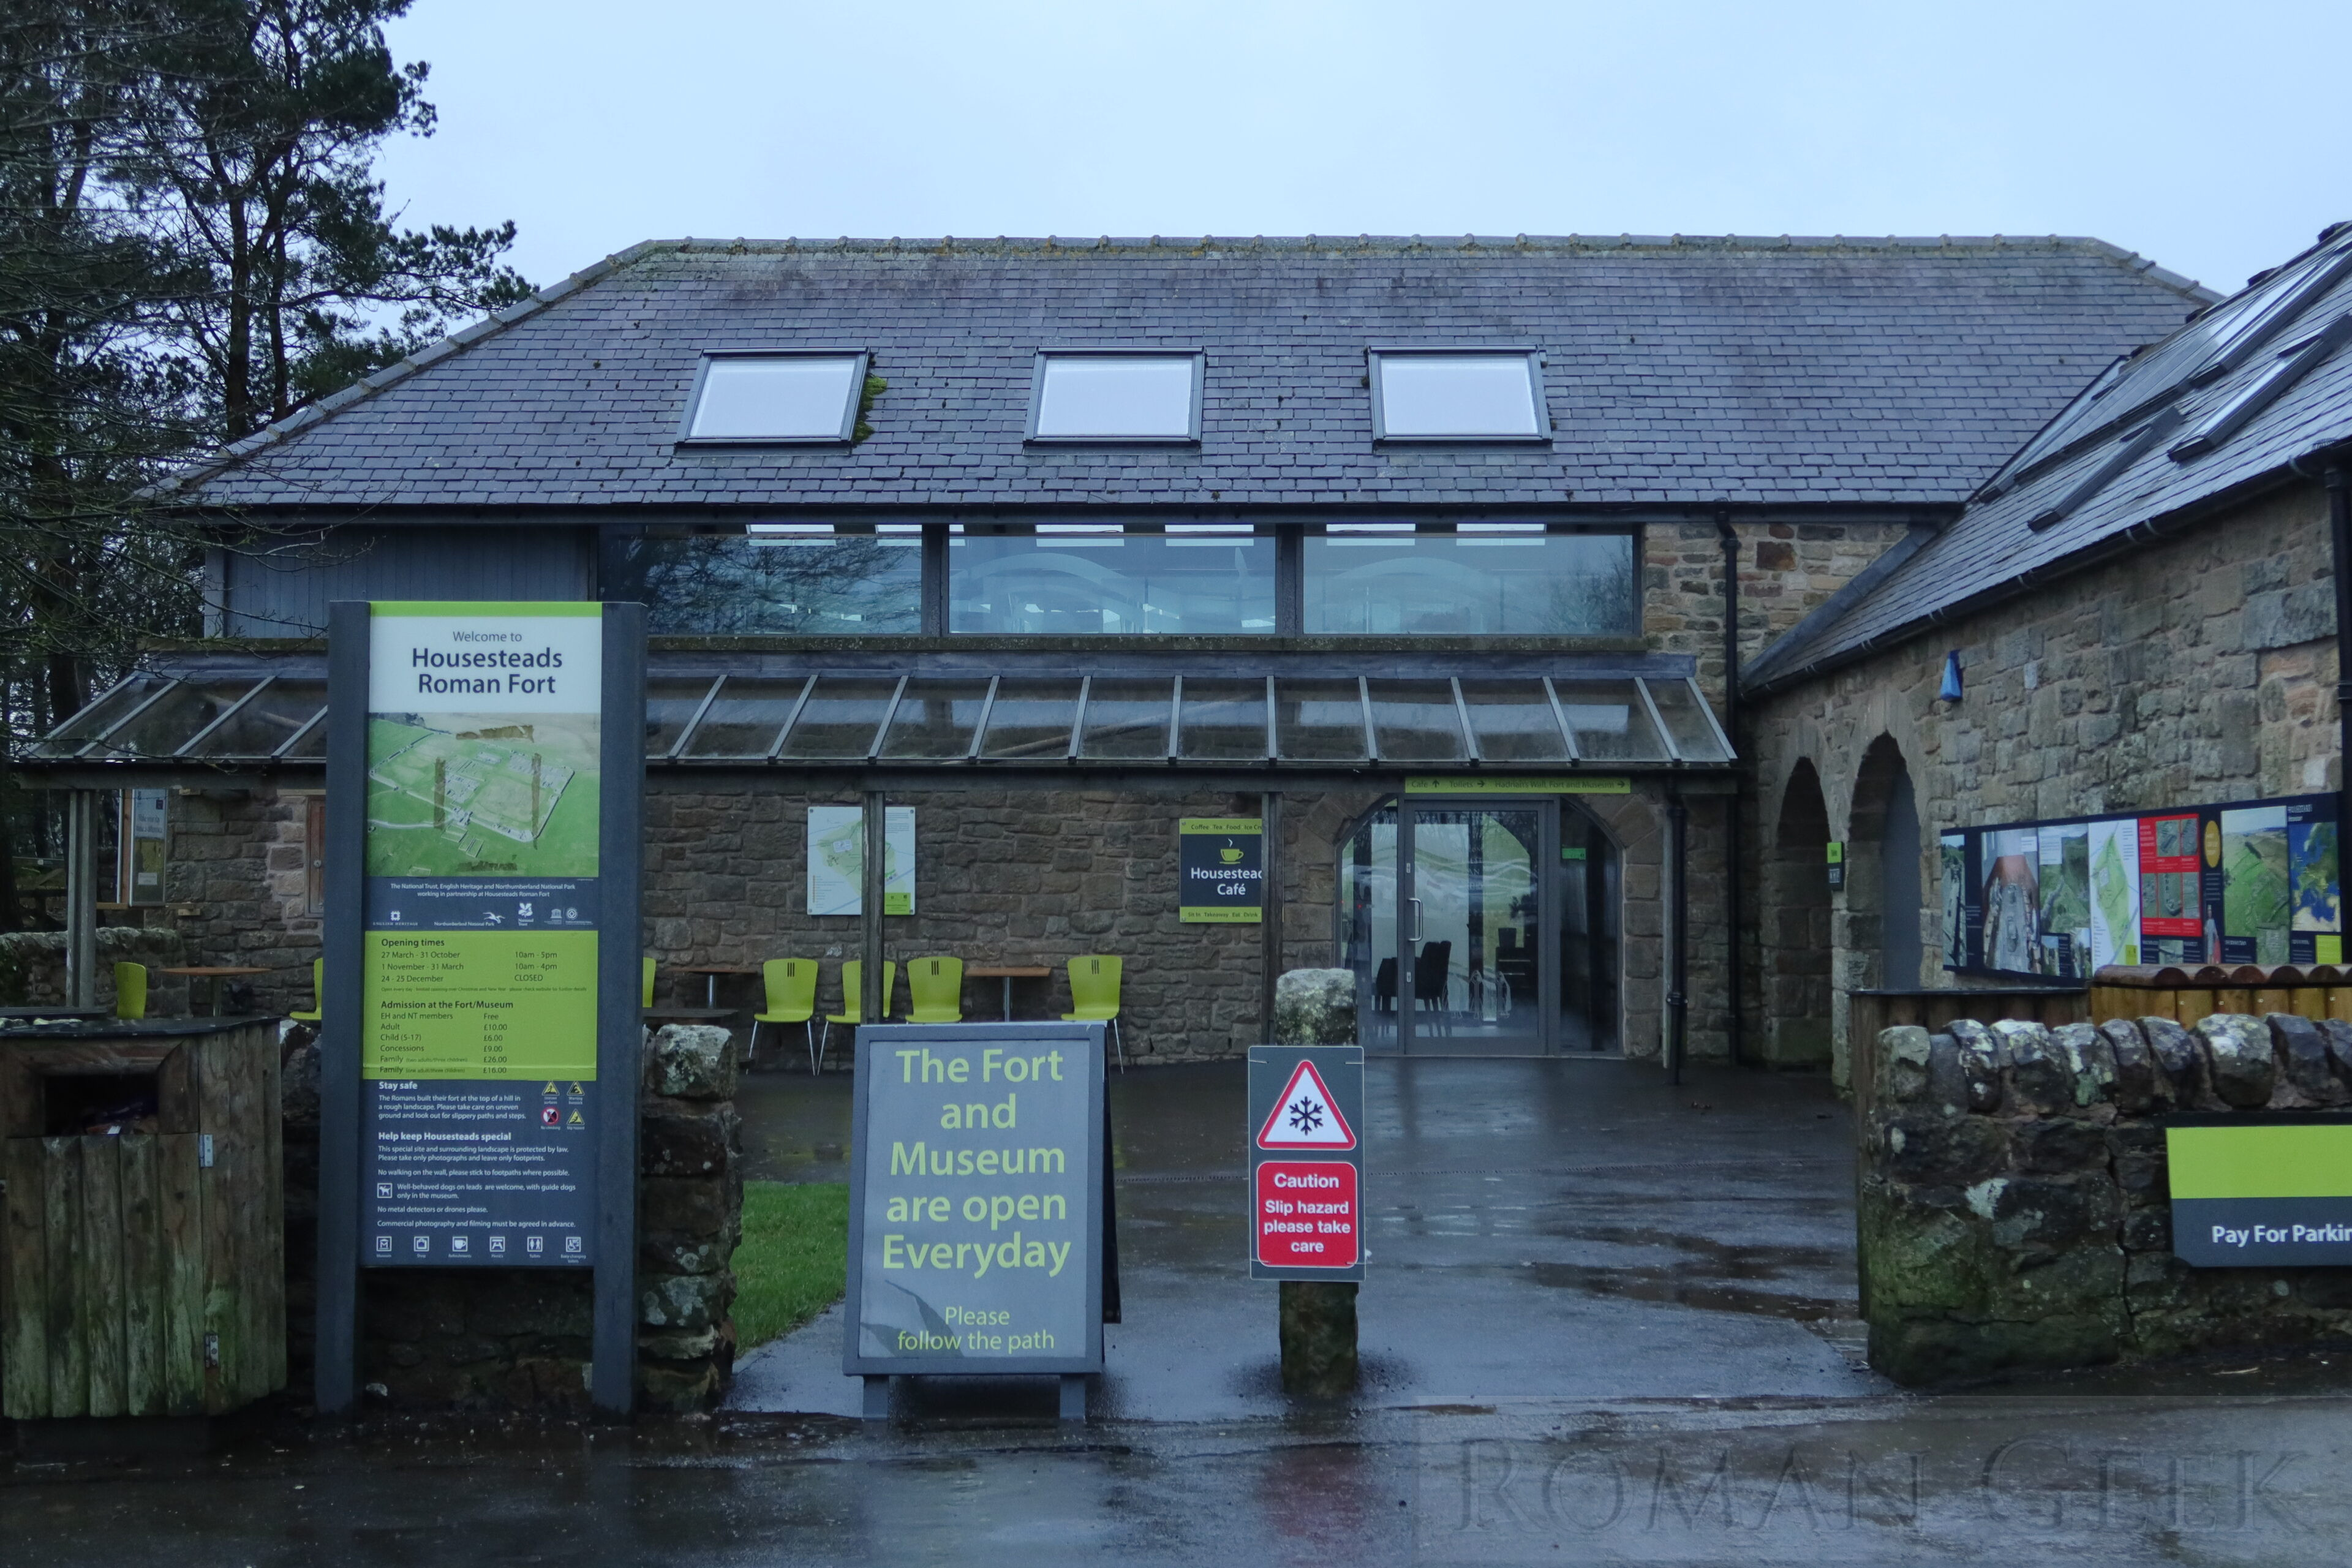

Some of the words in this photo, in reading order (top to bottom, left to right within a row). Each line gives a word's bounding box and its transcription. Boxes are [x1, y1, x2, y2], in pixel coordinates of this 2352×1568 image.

[453, 631, 507, 642] Welcome
[510, 633, 522, 642] to
[413, 647, 562, 668] Housesteads
[419, 674, 500, 693] Roman
[509, 674, 556, 693] Fort
[1217, 883, 1246, 895] Café
[381, 938, 419, 948] Opening
[541, 963, 557, 971] 4pm
[895, 1049, 970, 1083] The
[983, 1049, 1063, 1082] Fort
[379, 1081, 398, 1091] Stay
[941, 1093, 1016, 1129] and
[379, 1132, 399, 1142] Help
[401, 1132, 422, 1142] keep
[424, 1132, 480, 1140] Housesteads
[481, 1132, 511, 1142] special
[891, 1142, 1065, 1175] Museum
[397, 1183, 439, 1193] Well-behaved
[541, 1183, 559, 1192] guide
[1274, 1173, 1339, 1188] Caution
[886, 1196, 951, 1222] are
[963, 1194, 1066, 1232] open
[1265, 1200, 1294, 1216] Slip
[1297, 1200, 1349, 1214] hazard
[1264, 1219, 1314, 1235] please
[1317, 1220, 1351, 1234] take
[2212, 1226, 2250, 1247] Pay
[2253, 1225, 2288, 1242] For
[883, 1231, 1071, 1279] Everyday
[1291, 1242, 1324, 1253] care
[943, 1306, 1010, 1327] Please
[896, 1329, 962, 1354] follow
[967, 1330, 1002, 1350] the
[1008, 1329, 1054, 1354] path
